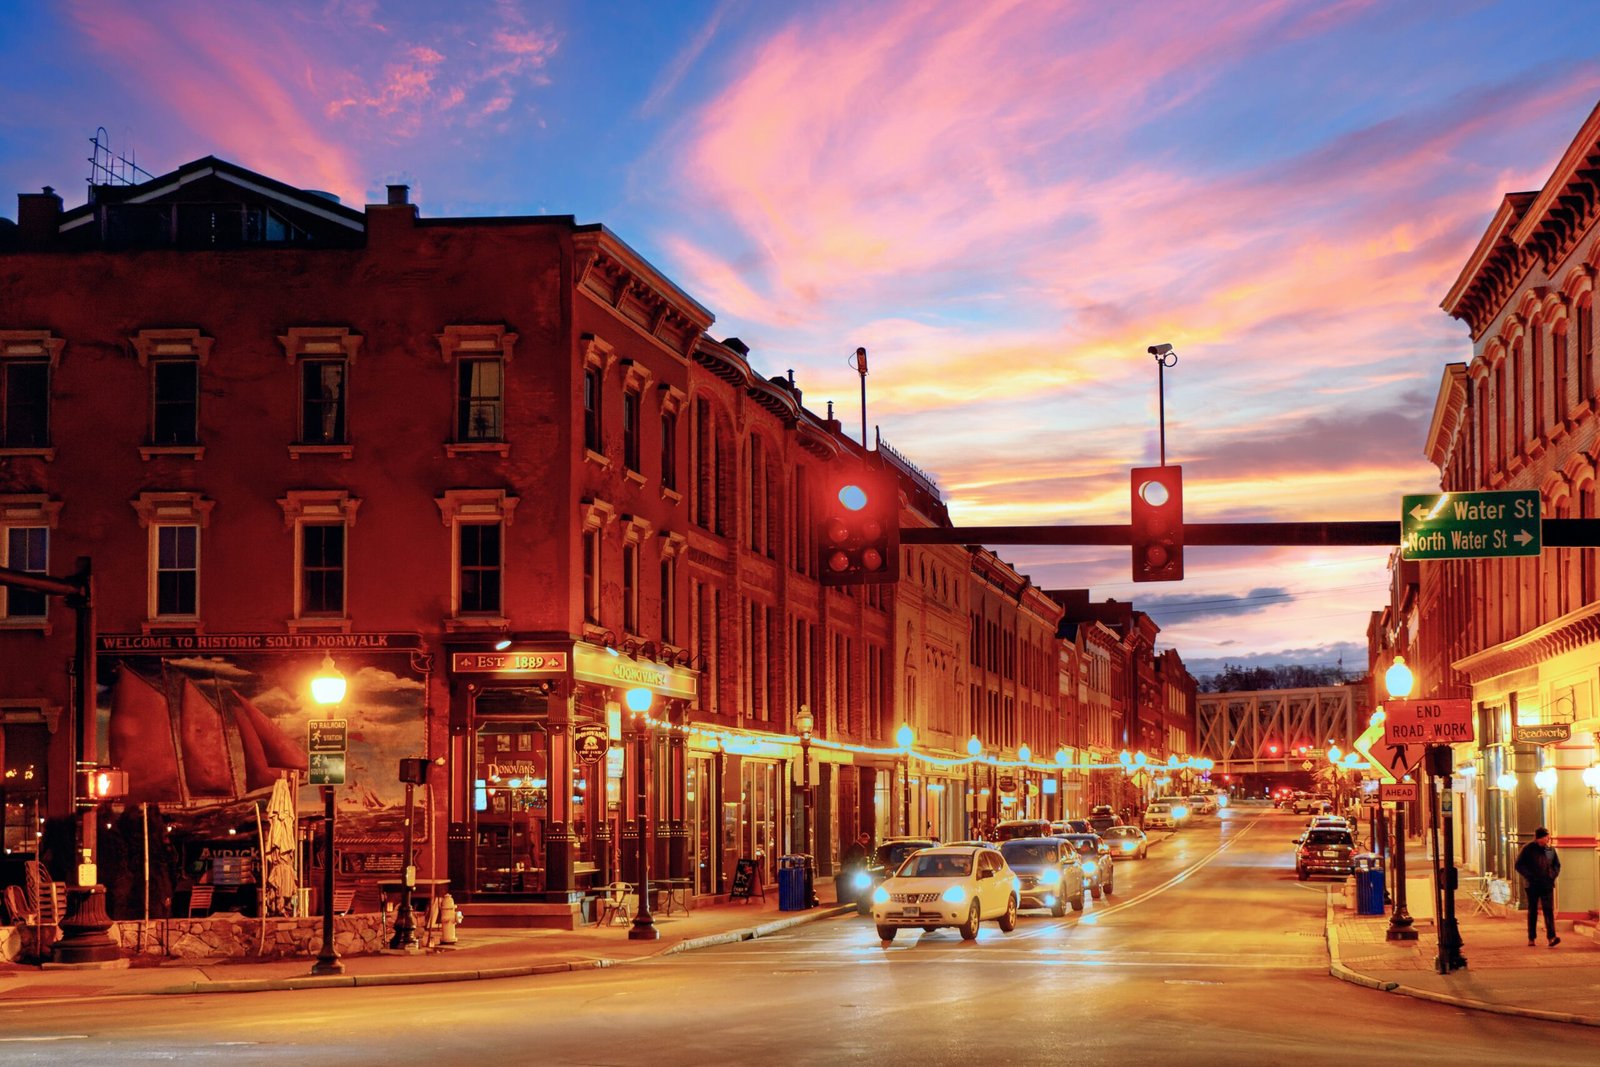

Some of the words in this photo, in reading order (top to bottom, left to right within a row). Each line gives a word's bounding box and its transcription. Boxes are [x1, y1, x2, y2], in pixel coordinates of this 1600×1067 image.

[1454, 501, 1506, 521] Water
[1514, 499, 1534, 519] St
[1408, 532, 1446, 552] North
[1451, 531, 1488, 550] Water
[1493, 529, 1507, 549] St
[103, 637, 172, 649] WELCOME
[176, 637, 193, 648] TO
[197, 636, 262, 648] HISTORIC
[266, 636, 311, 647] SOUTH
[316, 635, 388, 647] NORWALK
[477, 656, 506, 668] EST.
[514, 656, 544, 669] 1889
[1416, 705, 1441, 718] END
[319, 721, 346, 729] RAILROAD
[1393, 725, 1424, 738] ROAD
[1434, 723, 1467, 737] WORK
[1518, 727, 1568, 740] Beadworks
[1364, 794, 1379, 804] 25
[1385, 788, 1413, 797] AHEAD
